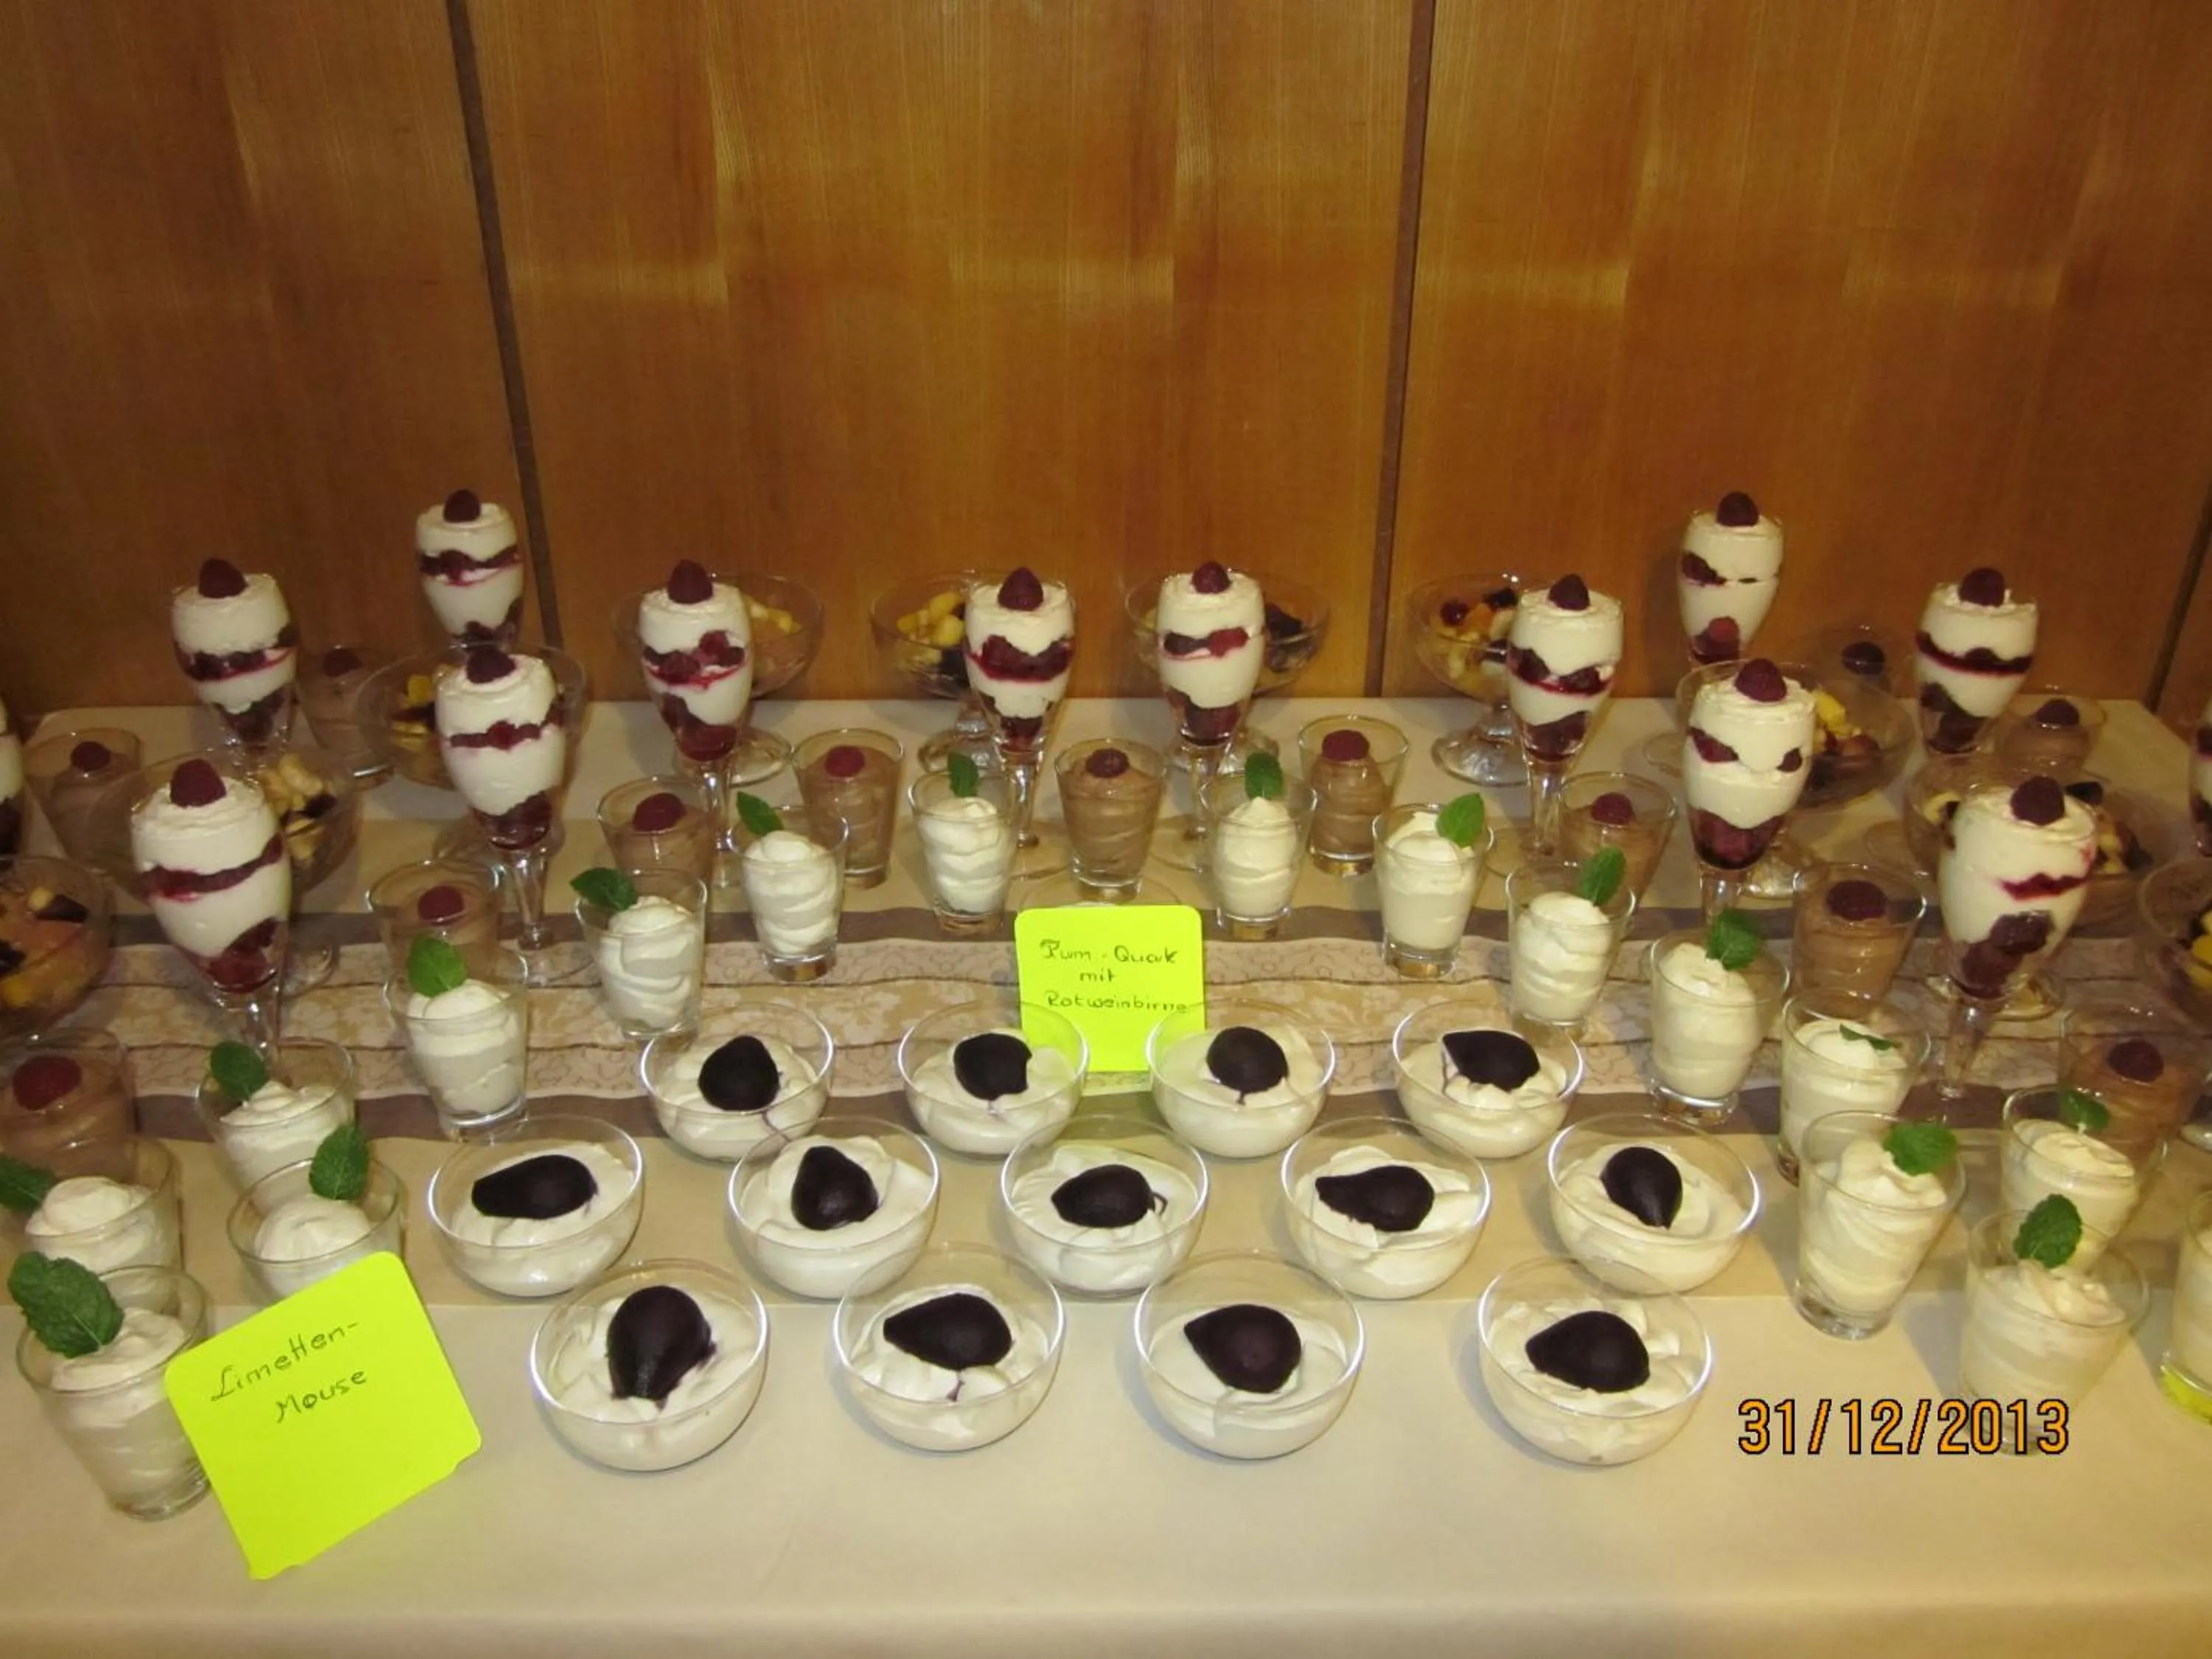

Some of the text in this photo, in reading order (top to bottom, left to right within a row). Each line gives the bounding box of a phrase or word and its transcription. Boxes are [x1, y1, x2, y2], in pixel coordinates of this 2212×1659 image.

[1113, 945, 1178, 964] Quark
[1079, 967, 1116, 982] mit
[275, 1370, 367, 1423] Mouse
